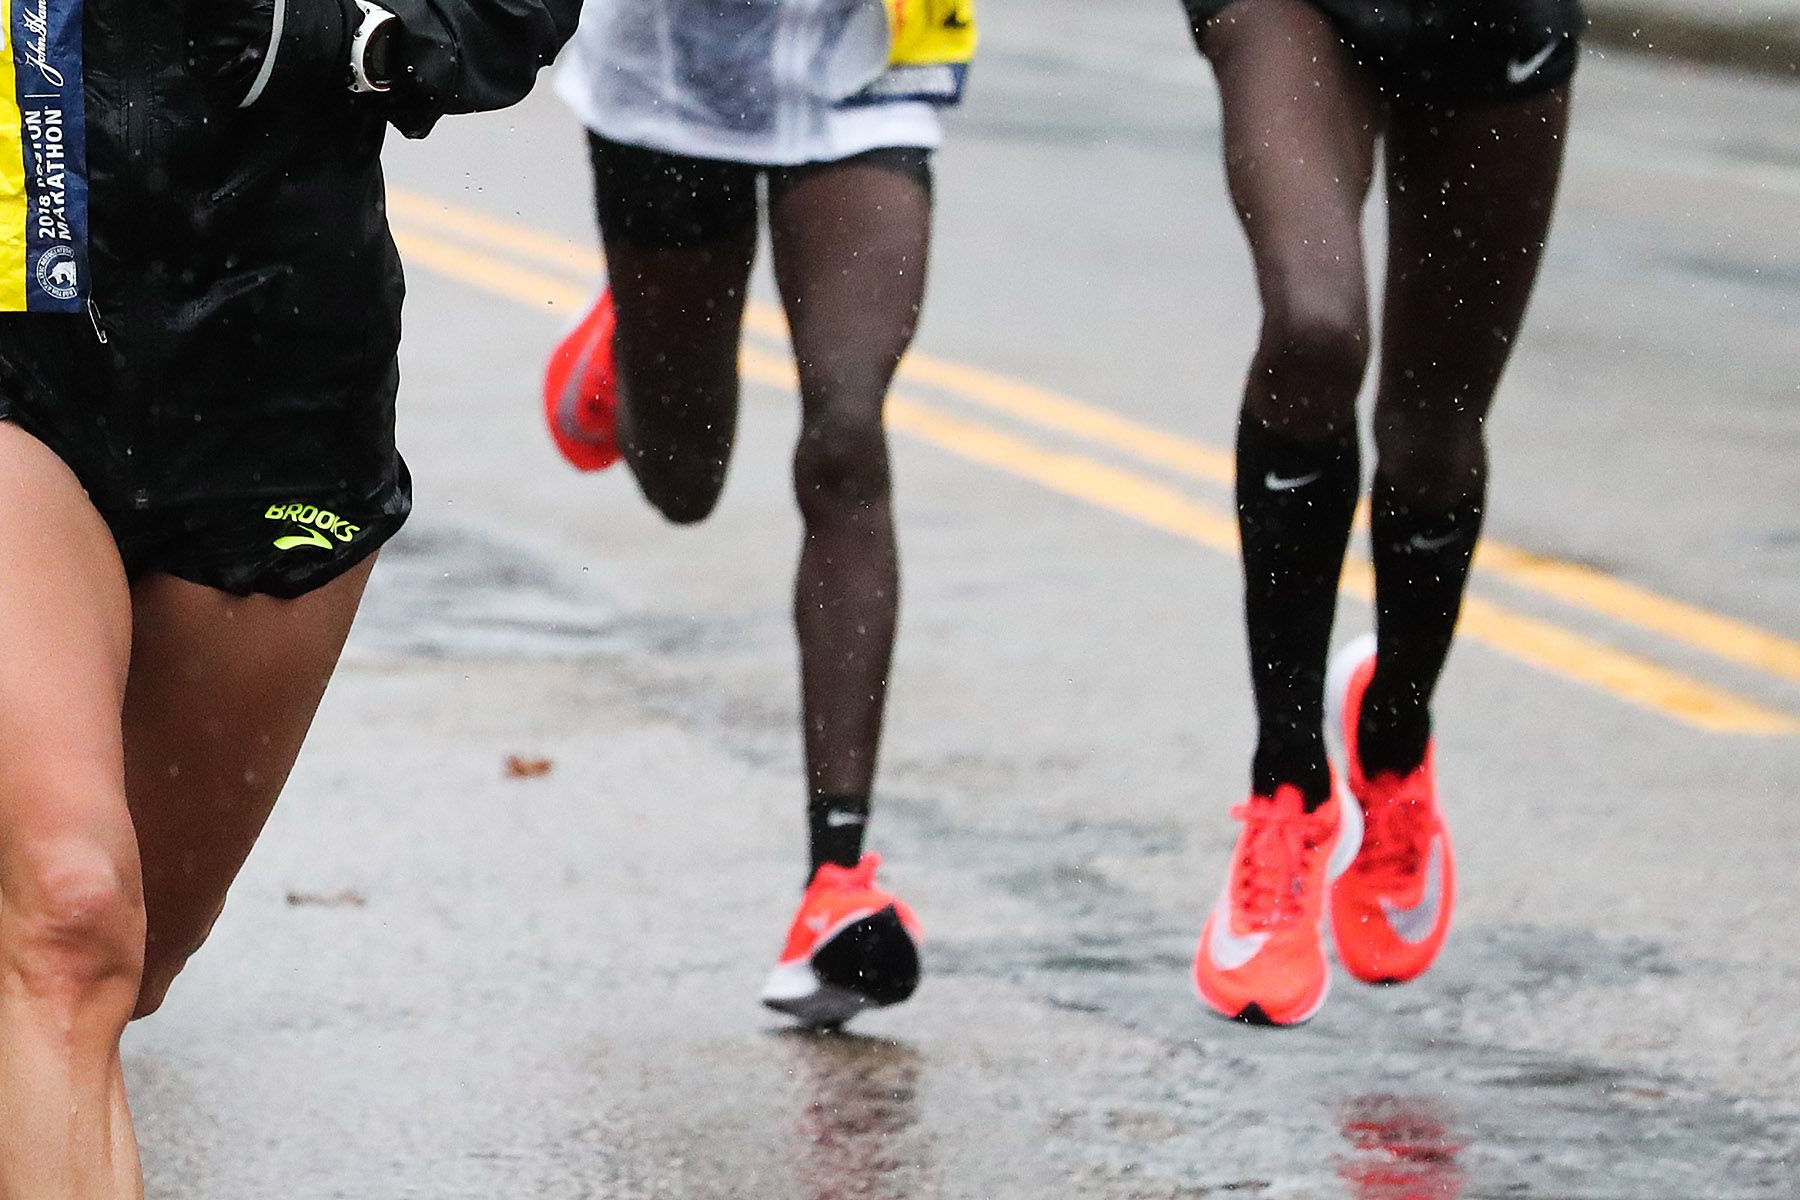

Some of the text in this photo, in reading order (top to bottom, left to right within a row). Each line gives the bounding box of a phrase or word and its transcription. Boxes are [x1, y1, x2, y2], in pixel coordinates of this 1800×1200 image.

[24, 37, 64, 87] John
[45, 108, 72, 241] MARATHON
[38, 195, 56, 239] 2018
[264, 503, 361, 542] BROOKS
